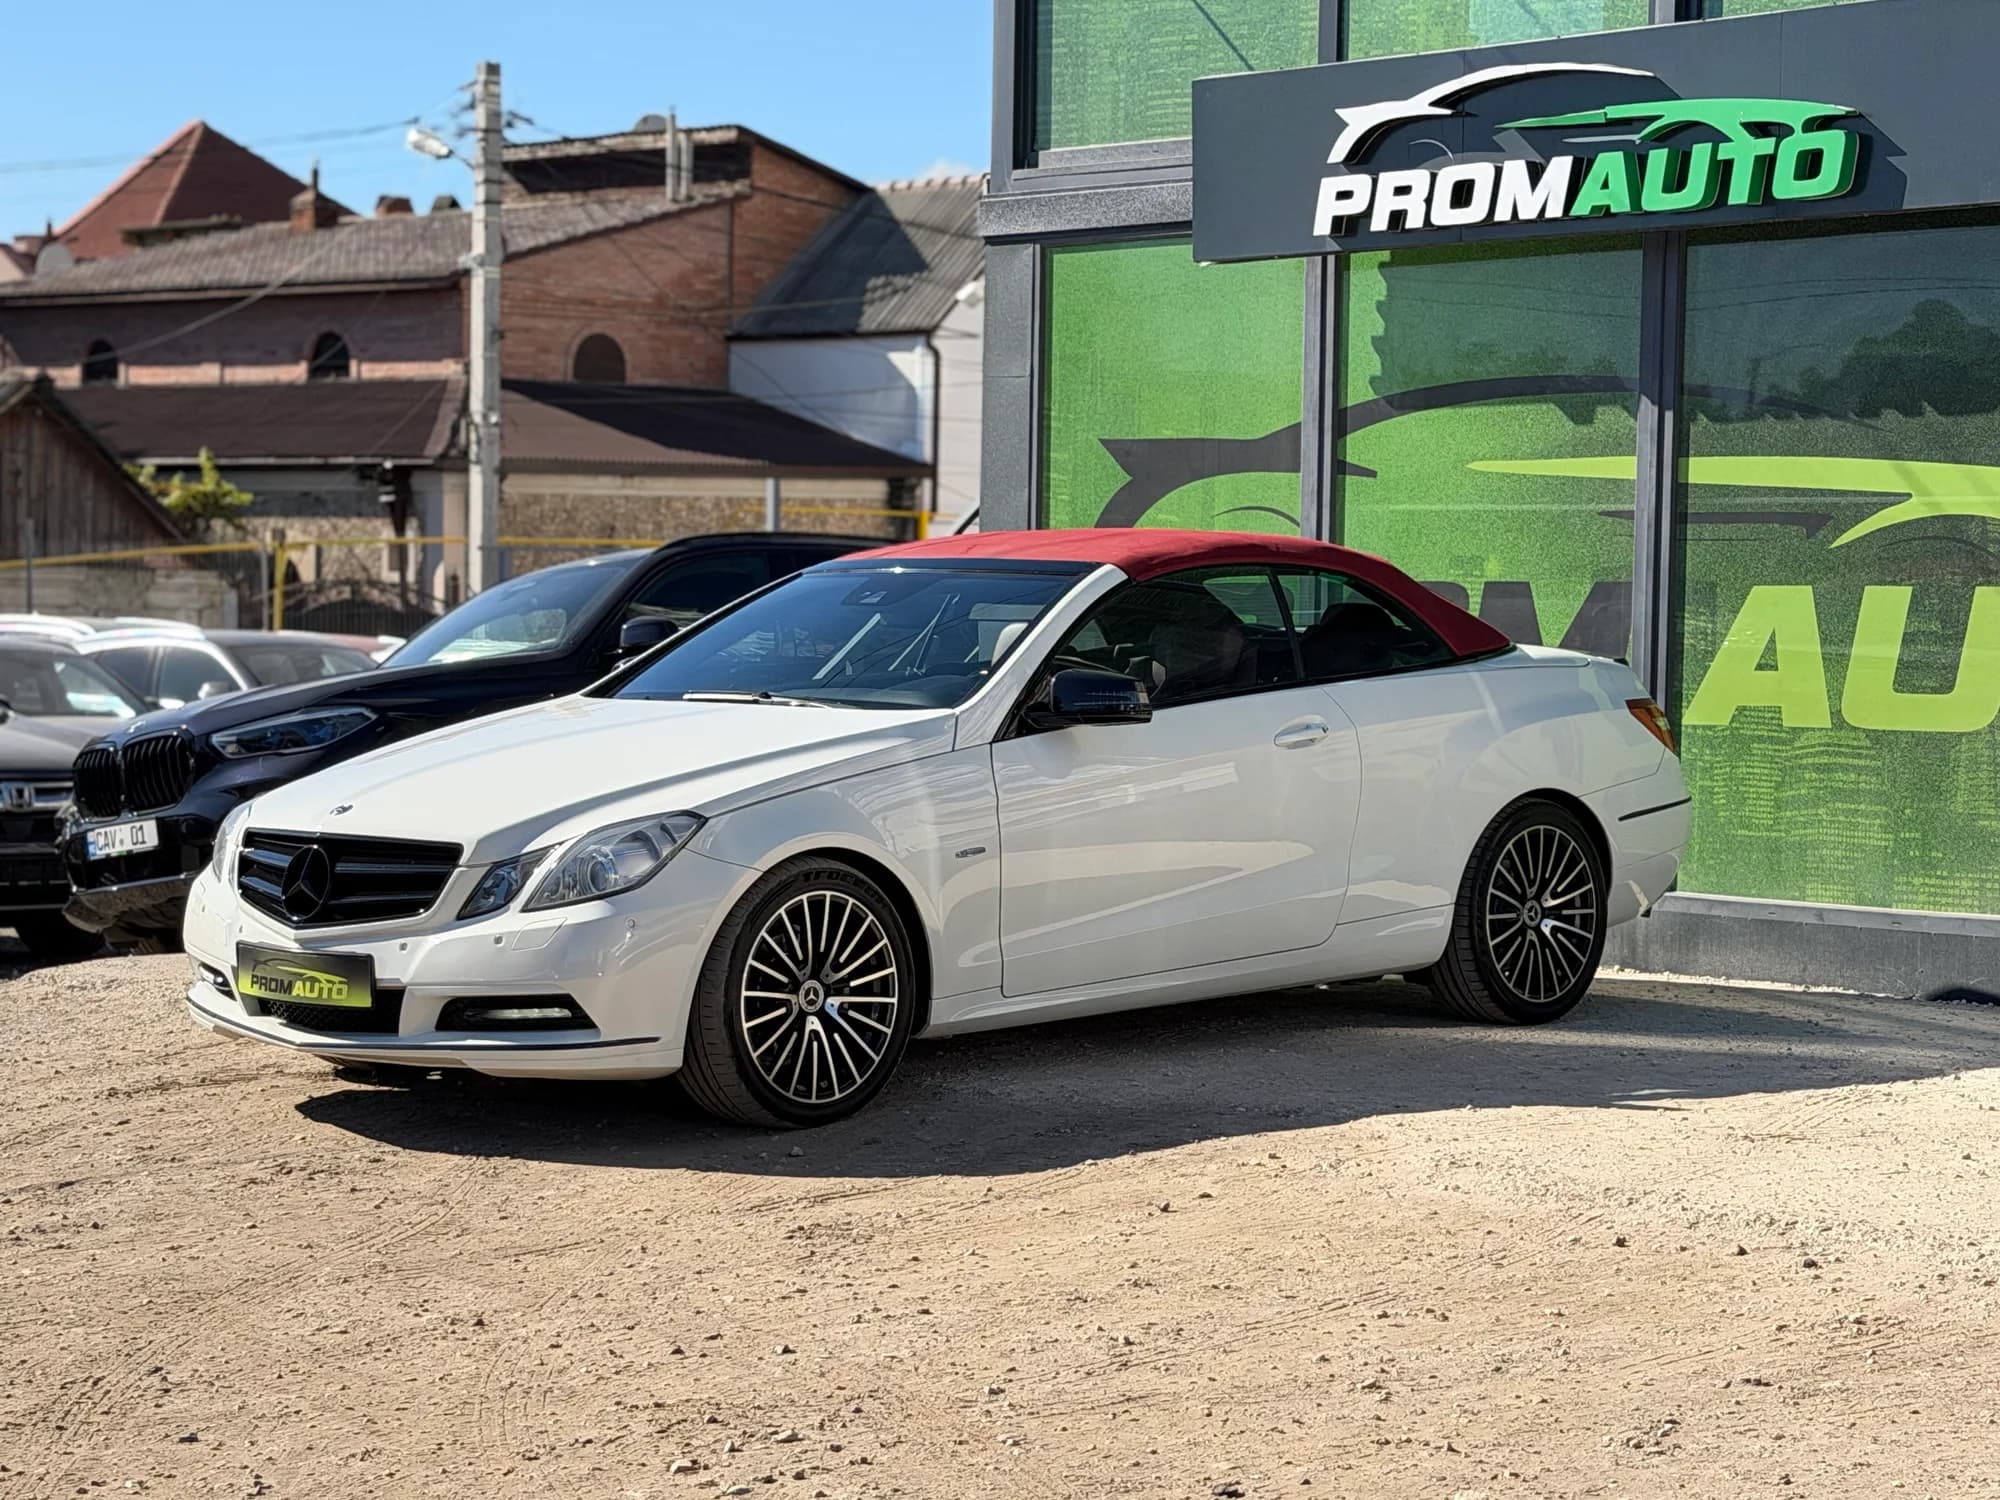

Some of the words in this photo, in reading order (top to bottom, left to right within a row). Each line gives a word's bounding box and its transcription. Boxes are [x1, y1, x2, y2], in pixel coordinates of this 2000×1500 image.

[1313, 129, 1858, 237] PROMAUTO
[95, 828, 117, 852] CAV
[130, 824, 147, 847] 01
[250, 973, 349, 1000] PROMAUTO
